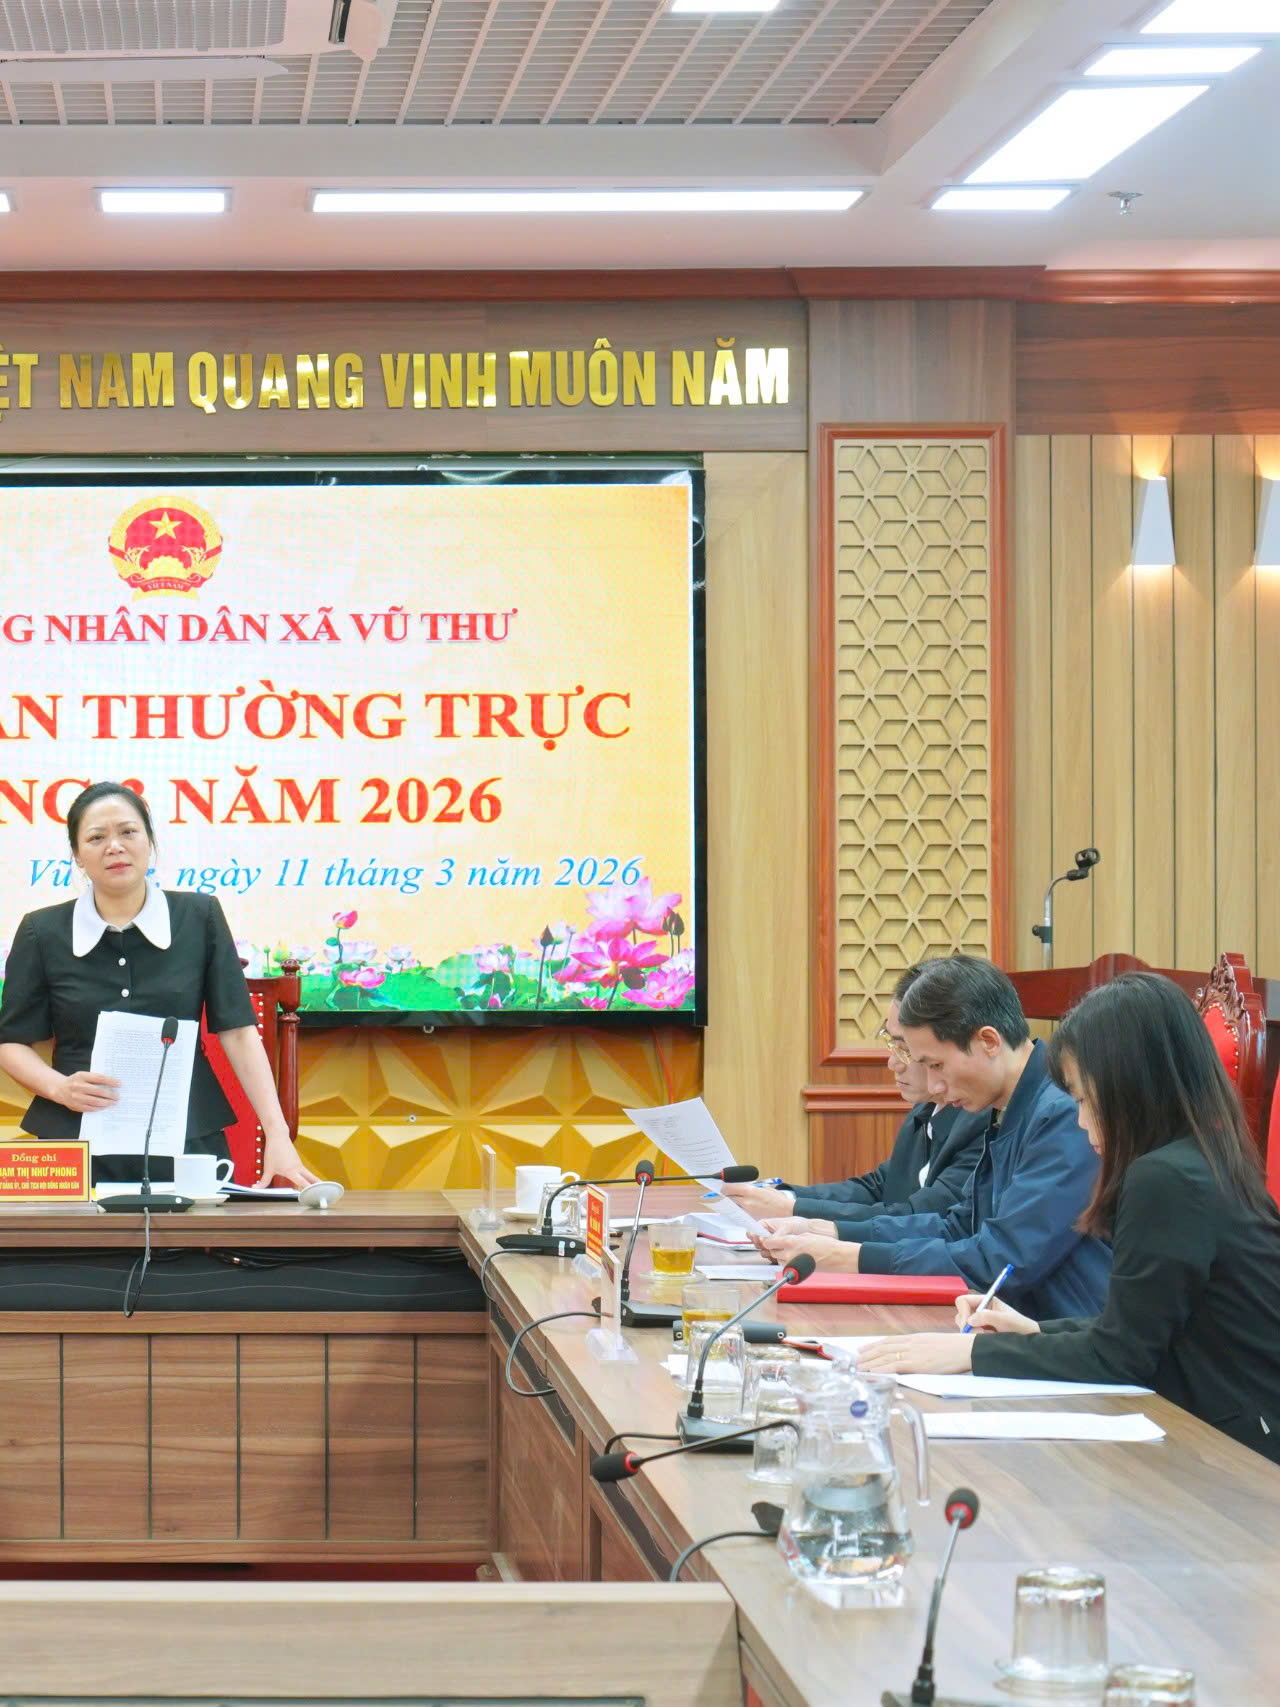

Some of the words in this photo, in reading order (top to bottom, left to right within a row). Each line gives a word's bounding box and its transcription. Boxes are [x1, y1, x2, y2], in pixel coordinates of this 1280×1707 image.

[59, 352, 175, 409] NAM
[188, 351, 363, 414] QUANG
[380, 352, 497, 409] VINH
[509, 338, 656, 407] MUÔN
[672, 337, 789, 406] NĂM
[45, 606, 167, 642] NHÂN
[179, 606, 269, 642] DÂN
[280, 607, 340, 642] XÃ
[350, 606, 410, 642] VŨ
[420, 608, 518, 641] THƯ
[82, 680, 406, 740] THƯỜNG
[425, 685, 631, 751] TRỰC
[169, 765, 340, 824] NĂM
[361, 777, 503, 823] 2026
[30, 859, 73, 887] Vũ
[176, 858, 261, 894] ngày
[276, 858, 307, 887] 11
[324, 858, 424, 894] tháng
[435, 858, 456, 887] 3
[468, 859, 541, 887] năm
[554, 857, 641, 887] 2026
[11, 1153, 39, 1163] Đồng
[41, 1154, 57, 1162] chí
[17, 1167, 30, 1179] THỊ
[31, 1166, 49, 1177] NHƯ
[50, 1167, 77, 1177] PHONG
